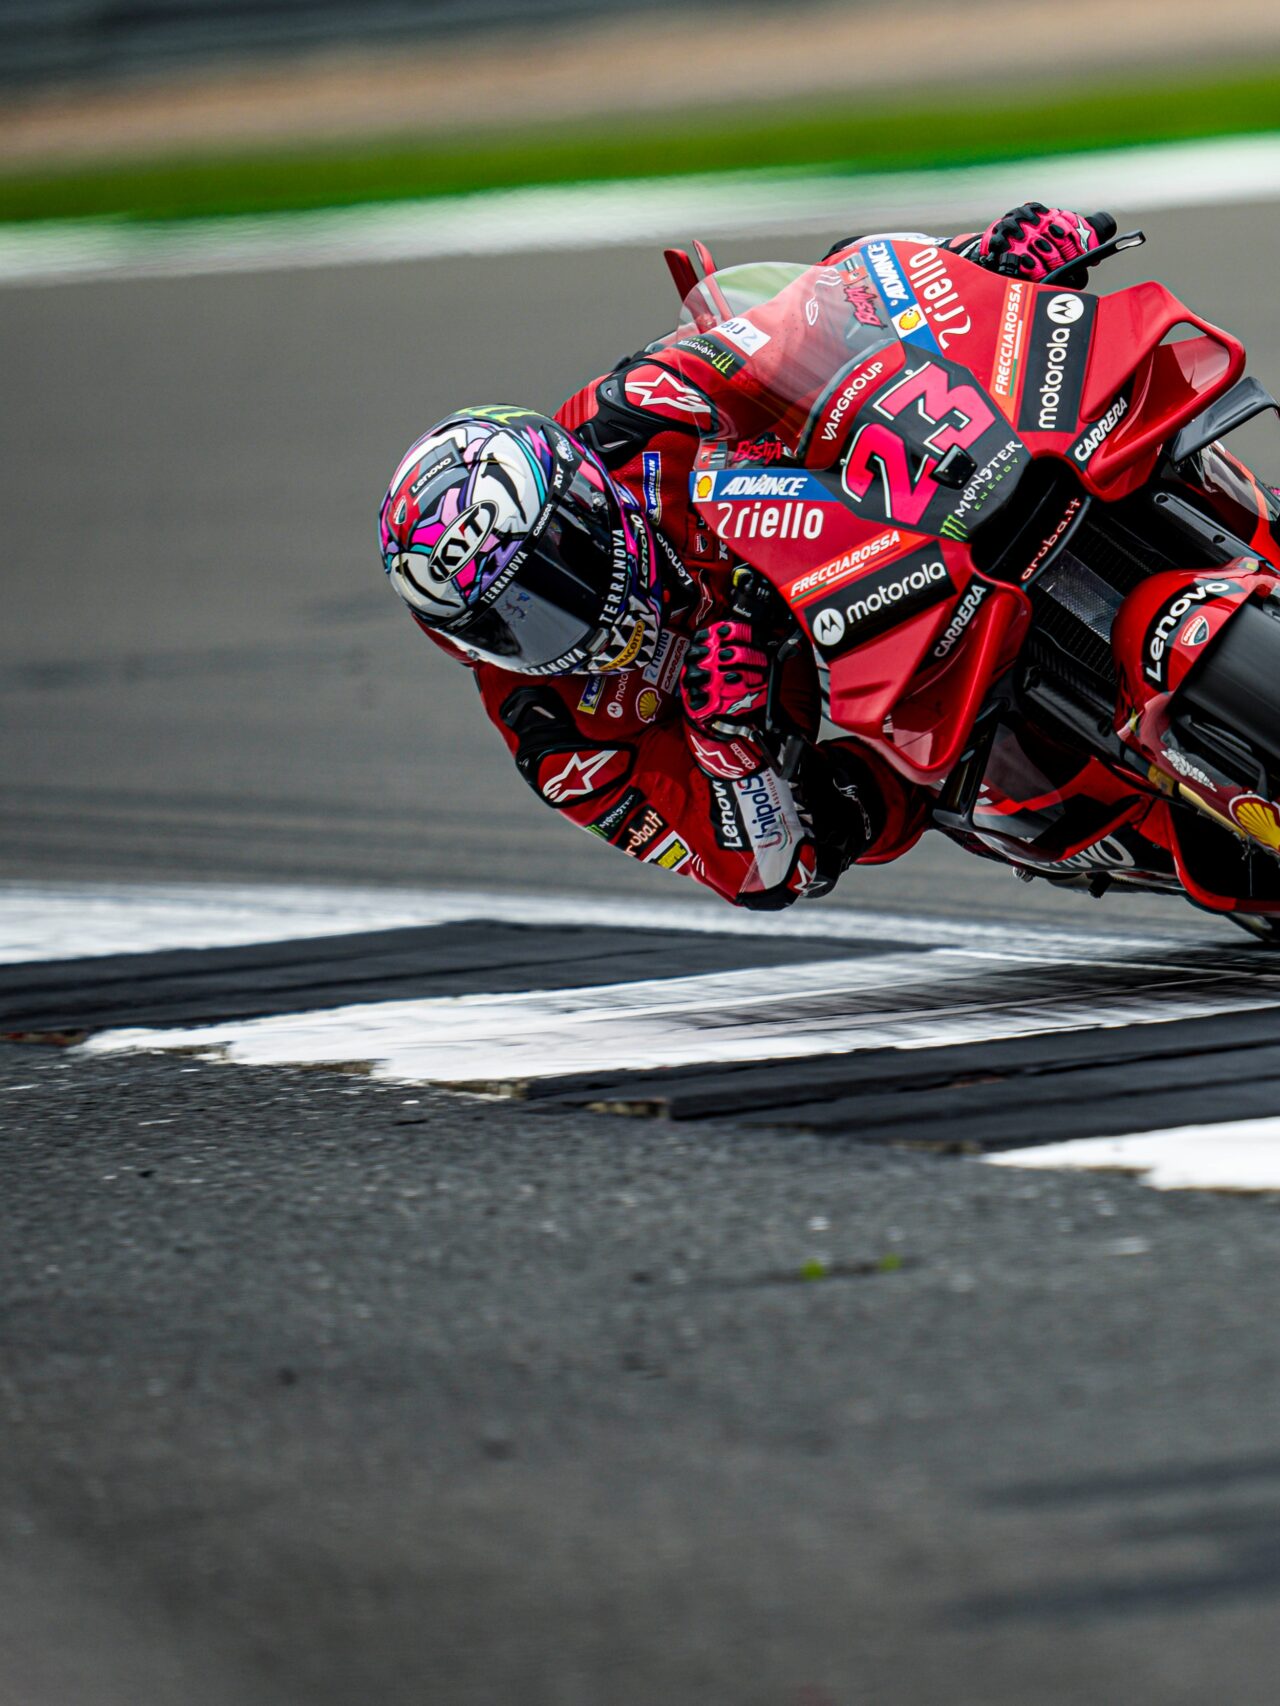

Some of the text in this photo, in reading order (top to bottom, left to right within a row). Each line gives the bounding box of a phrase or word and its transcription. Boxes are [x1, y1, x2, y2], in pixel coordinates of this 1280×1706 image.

[995, 283, 1024, 396] FRECCIAROSSA
[821, 361, 884, 442] VARGROUP
[1038, 327, 1071, 430] motorola
[841, 361, 996, 526] 23
[1074, 397, 1128, 462] CARRERA
[411, 457, 452, 493] Lenovo
[648, 459, 657, 506] MICHELIN
[720, 474, 808, 497] ADVANCE
[953, 440, 1024, 518] MONSTER
[974, 457, 1020, 511] ENERGY
[630, 514, 648, 589] Lenovo
[656, 532, 694, 586] Lenovo
[790, 530, 901, 597] FRECCIAROSSA
[1021, 498, 1081, 581] aruba.it
[480, 551, 528, 604] TERRANOVA
[599, 530, 626, 623] TERRANOVA
[846, 561, 947, 624] motorola
[934, 583, 987, 658] CARRERA
[1146, 582, 1230, 682] Lenovo
[712, 780, 743, 848] Lenov
